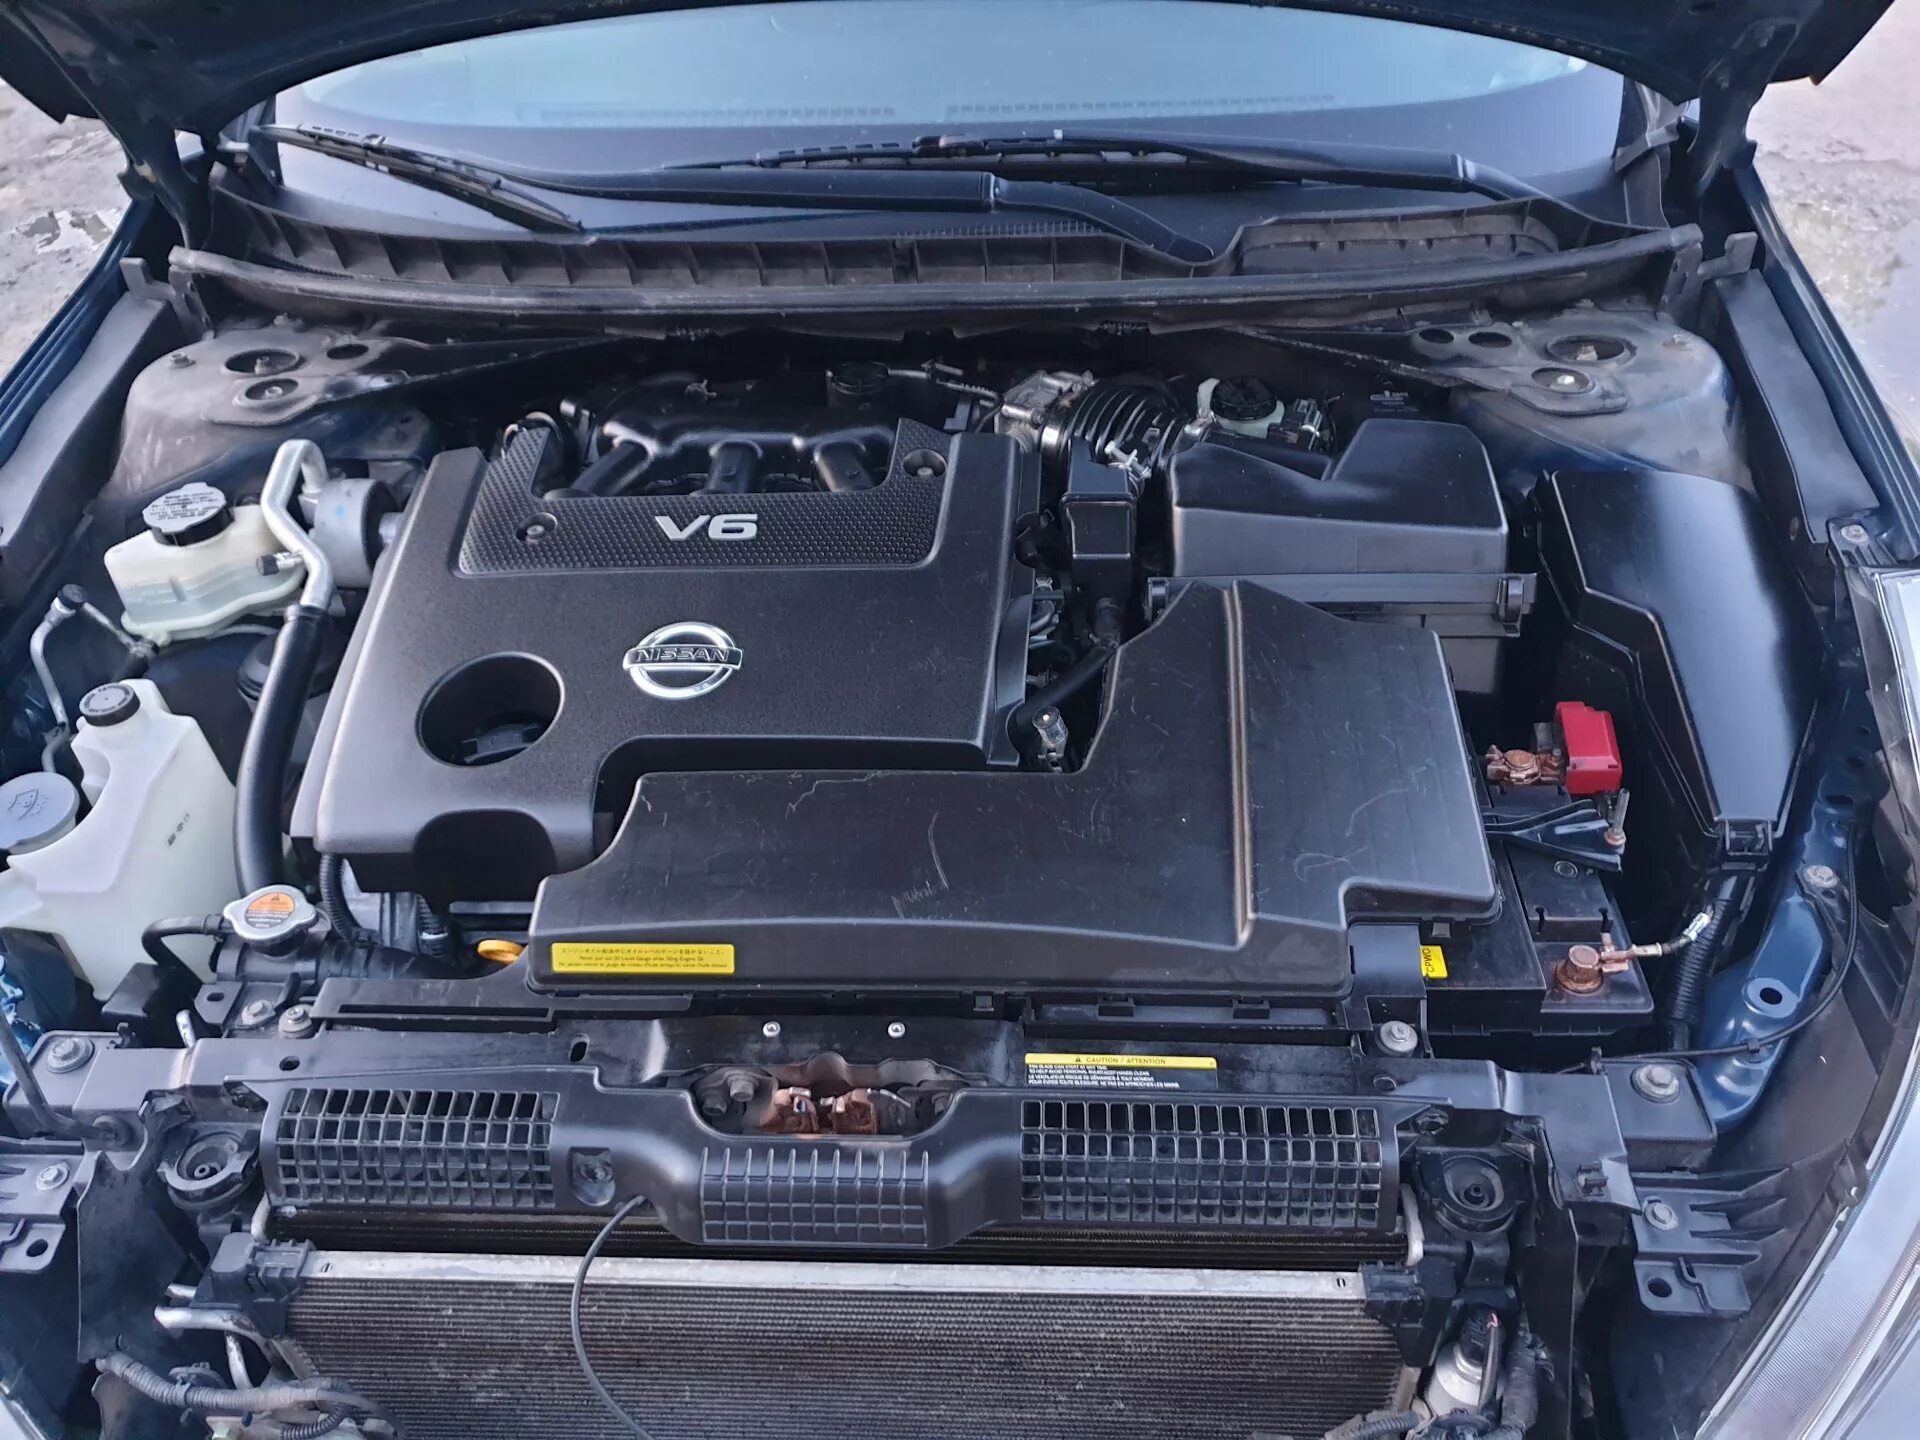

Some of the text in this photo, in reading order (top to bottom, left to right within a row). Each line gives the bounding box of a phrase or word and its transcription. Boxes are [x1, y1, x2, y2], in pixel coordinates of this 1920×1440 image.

[655, 514, 758, 540] V6
[636, 647, 731, 662] NISSAN
[1127, 1057, 1166, 1065] ATTENTION
